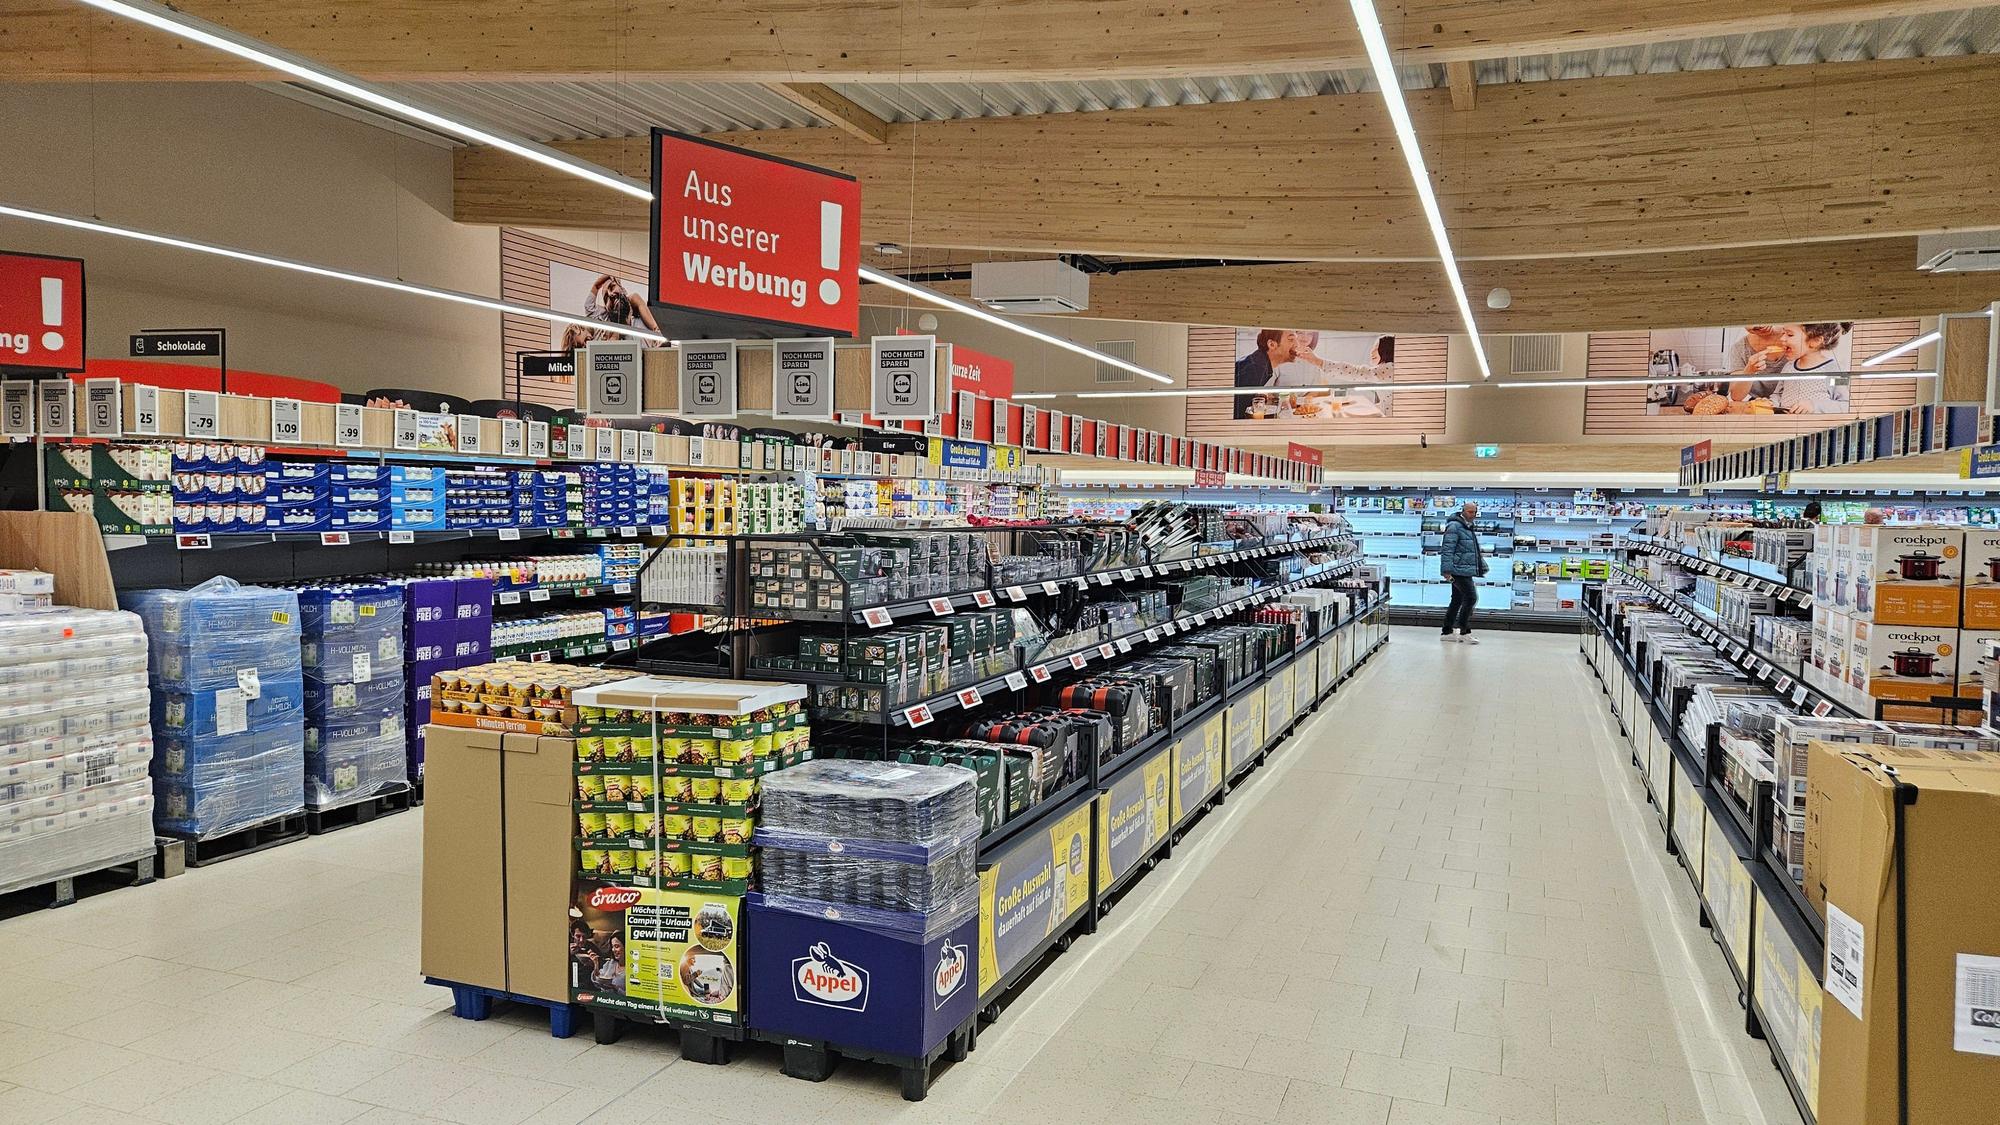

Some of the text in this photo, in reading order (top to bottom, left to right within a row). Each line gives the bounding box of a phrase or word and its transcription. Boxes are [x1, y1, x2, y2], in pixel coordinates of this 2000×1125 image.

[684, 170, 732, 207] Aus
[683, 215, 779, 254] unserer
[683, 252, 807, 308] Werbung
[157, 341, 206, 351] Schokolade
[903, 350, 923, 358] MEHR
[548, 362, 573, 372] Milch
[968, 364, 981, 382] Zeit
[796, 395, 809, 403] Plus
[895, 395, 909, 403] Plus
[192, 418, 213, 428] -.79
[277, 423, 297, 433] 1.09
[961, 419, 972, 431] 9.99
[341, 428, 358, 437] -.99
[399, 432, 414, 441] -.89
[462, 436, 476, 445] 1.59
[506, 440, 520, 448] -.99
[532, 441, 544, 449] -.79
[571, 444, 582, 452] 1.19
[599, 446, 610, 454] 1.09
[1894, 535, 1947, 547] crockpot
[417, 611, 432, 621] FREI
[458, 609, 471, 618] FREI
[1888, 632, 1941, 644] crockpot
[331, 645, 367, 654] H-VOLLMILCH
[456, 646, 470, 656] FREI
[417, 650, 432, 661] FREI
[369, 679, 400, 692] H-VOLLMILCH
[268, 702, 292, 713] H-MILCH
[476, 718, 526, 731] 5 Minuten Terrine
[333, 726, 368, 739] H-VOLLMILCH
[1111, 793, 1144, 832] Große Auswahl
[998, 862, 1051, 916] Große Auswahl
[591, 888, 640, 907] Erasco
[998, 905, 1026, 938] dauerhaft
[1026, 899, 1036, 915] auf
[938, 956, 962, 988] Appel
[803, 968, 857, 993] Appel
[596, 996, 615, 1006] Macht
[672, 1007, 697, 1016] wärmer!
